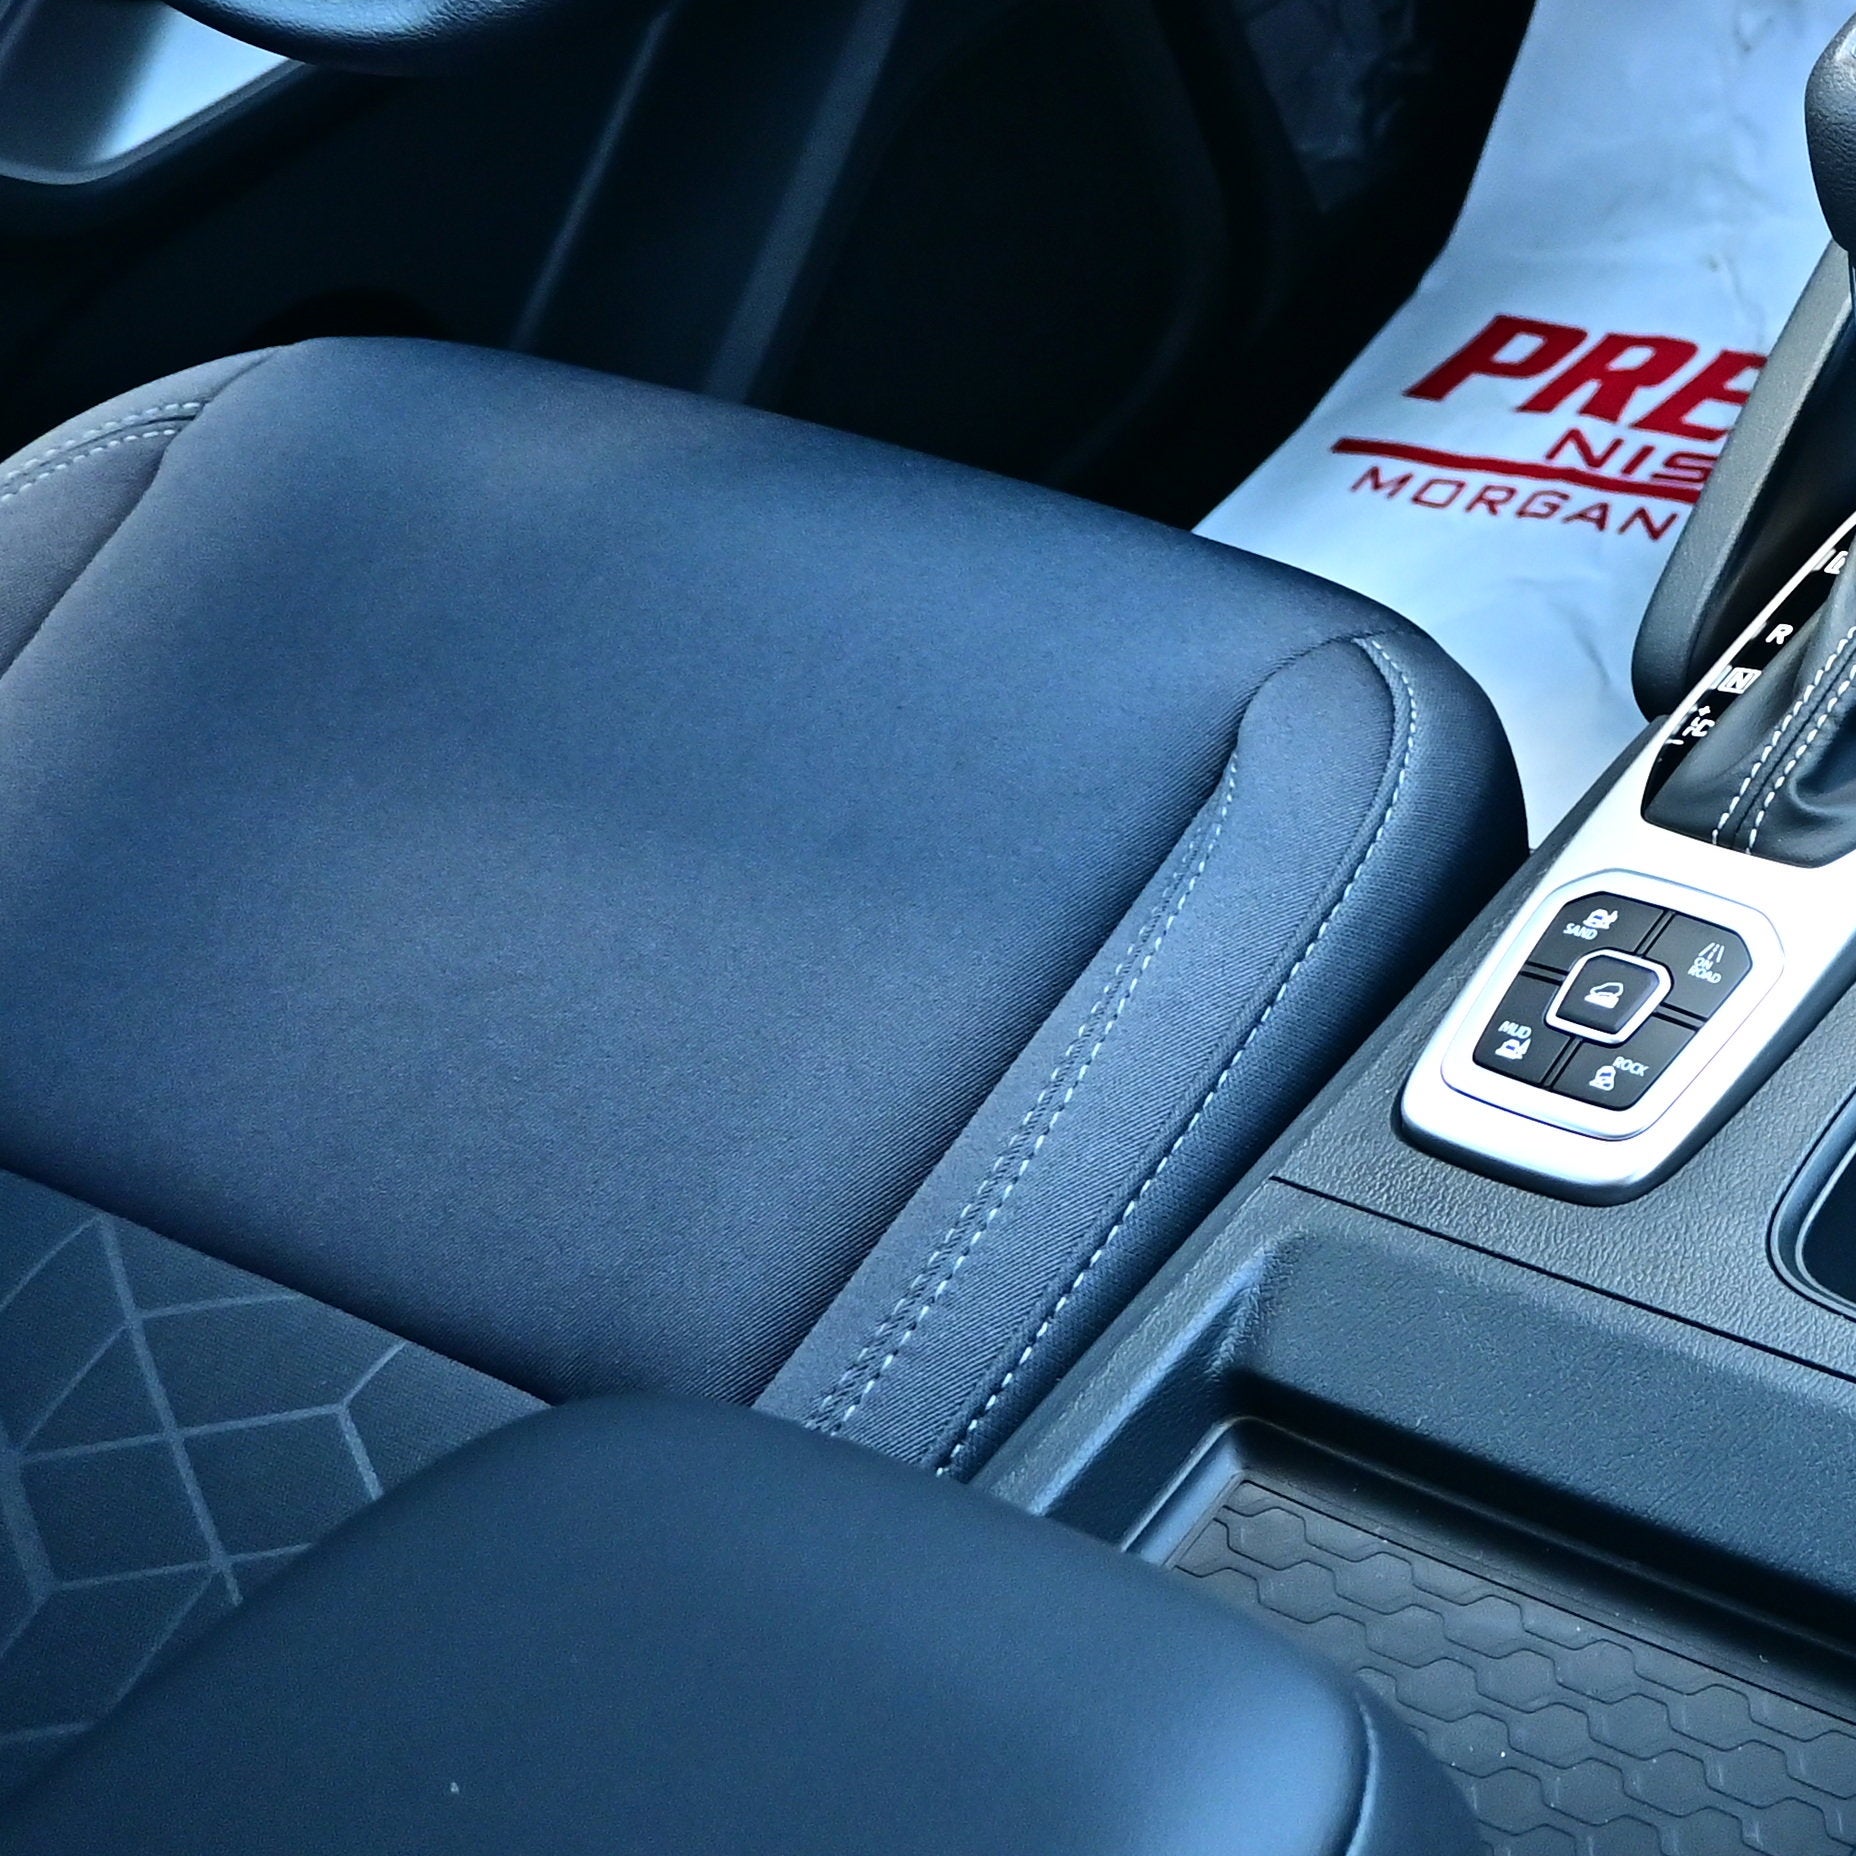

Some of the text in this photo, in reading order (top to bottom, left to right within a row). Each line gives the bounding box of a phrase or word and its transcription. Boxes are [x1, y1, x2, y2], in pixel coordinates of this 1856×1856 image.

[1765, 623, 1794, 644] R
[1563, 923, 1598, 941] SAND
[1694, 957, 1714, 972] ON
[1688, 966, 1722, 984] ROAD
[1498, 1021, 1532, 1039] MUD
[1613, 1056, 1649, 1077] ROCK
